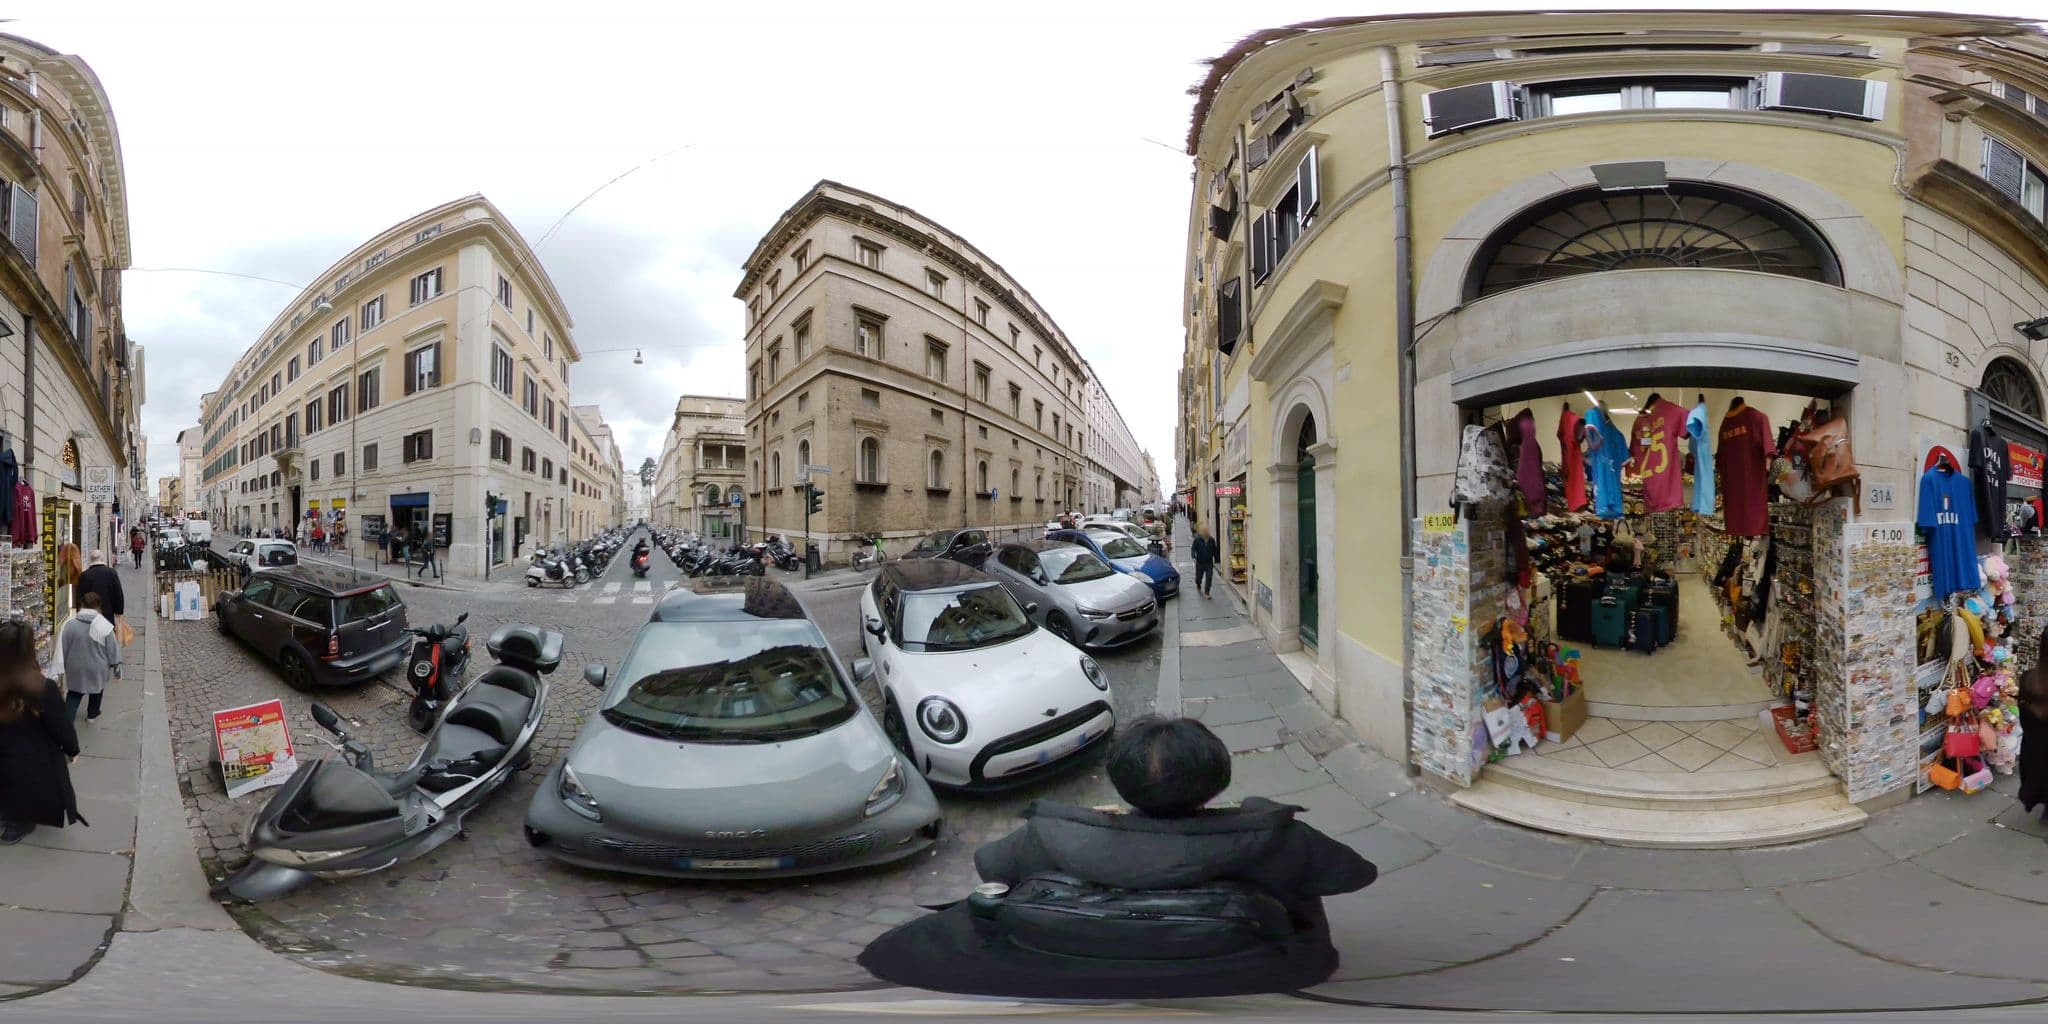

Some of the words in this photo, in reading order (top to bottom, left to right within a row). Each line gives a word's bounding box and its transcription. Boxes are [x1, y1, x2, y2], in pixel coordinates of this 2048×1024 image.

[1945, 352, 1960, 368] 32
[1639, 431, 1668, 479] 25
[87, 485, 111, 493] LEATHER
[91, 494, 106, 502] SHOP
[1870, 489, 1892, 503] 31A
[1871, 529, 1878, 539] €
[1882, 529, 1902, 541] 1,00
